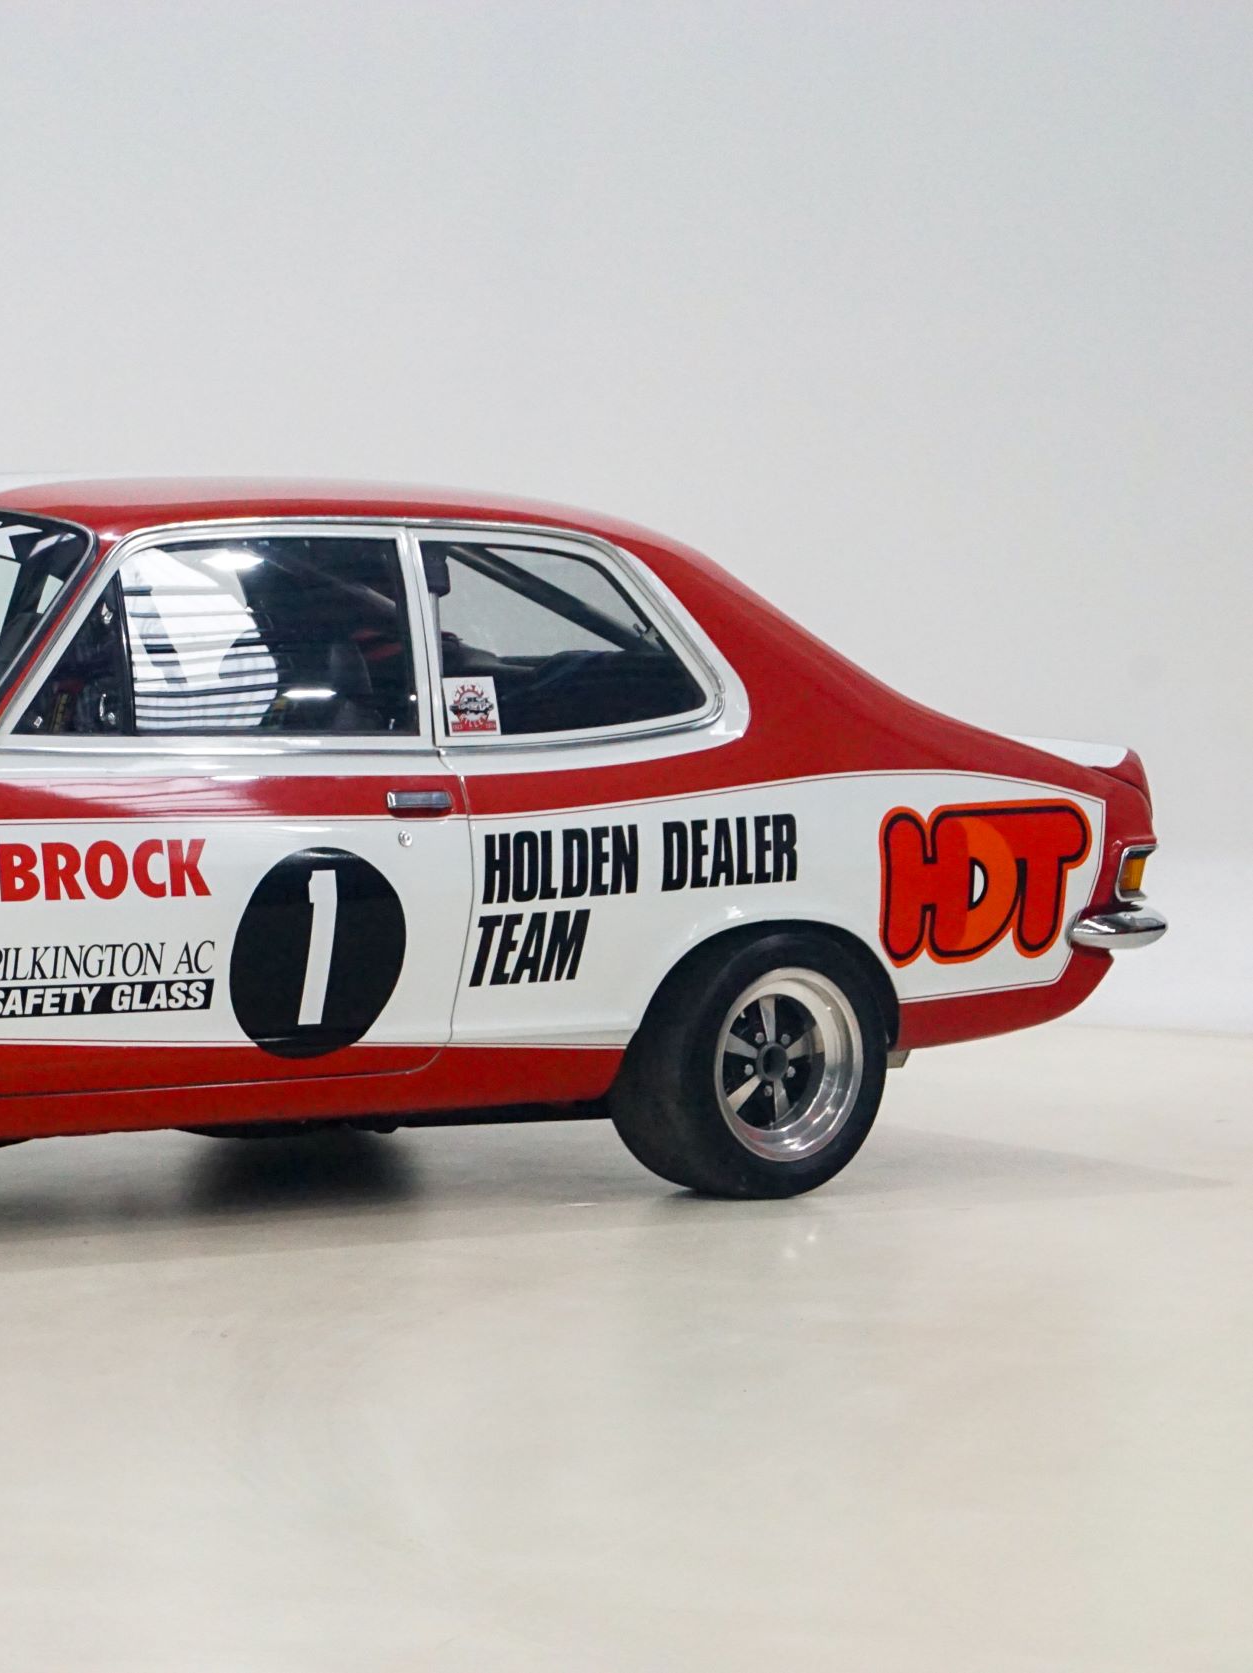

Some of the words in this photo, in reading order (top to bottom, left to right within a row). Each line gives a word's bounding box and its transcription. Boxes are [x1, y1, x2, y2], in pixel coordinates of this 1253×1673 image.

[481, 824, 639, 904] HOLDEN
[661, 813, 798, 892] DEALER
[879, 798, 1092, 968] HDT
[173, 940, 216, 974] AC
[297, 869, 338, 1026] 1
[468, 908, 591, 987] TEAM
[111, 981, 207, 1011] GLASS
